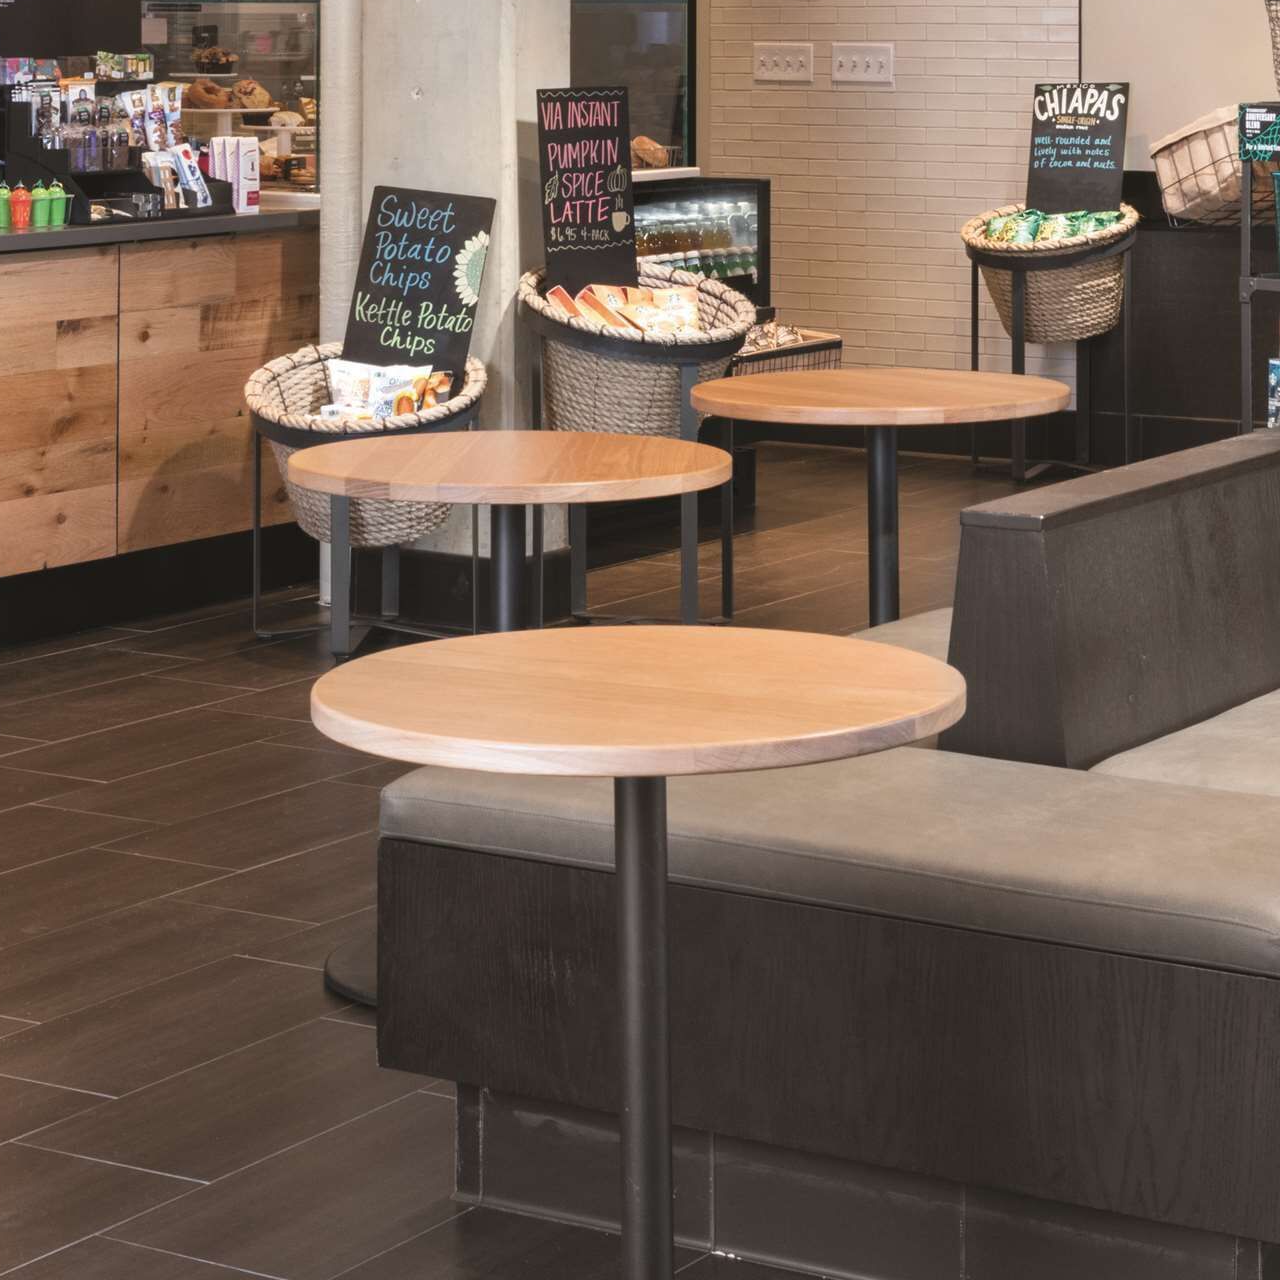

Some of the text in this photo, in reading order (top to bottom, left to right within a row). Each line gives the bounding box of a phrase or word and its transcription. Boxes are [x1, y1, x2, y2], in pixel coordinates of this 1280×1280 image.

[541, 101, 621, 131] VIA INSTANT
[1035, 88, 1126, 121] CHIAPAS
[548, 137, 619, 171] PUMPKIN
[1060, 147, 1082, 156] with
[1085, 148, 1110, 157] notes
[1094, 136, 1112, 145] and
[1034, 158, 1046, 169] of
[1049, 159, 1073, 168] cocoa
[1075, 158, 1091, 168] and
[561, 171, 604, 198] SPICE
[377, 194, 456, 233] Sweet
[549, 196, 612, 224] LATTE
[375, 230, 452, 264] Potato
[581, 226, 610, 241] 4-PACK
[370, 260, 432, 296] Chips
[355, 291, 473, 333] Kettle Potato
[380, 326, 436, 357] Chips
